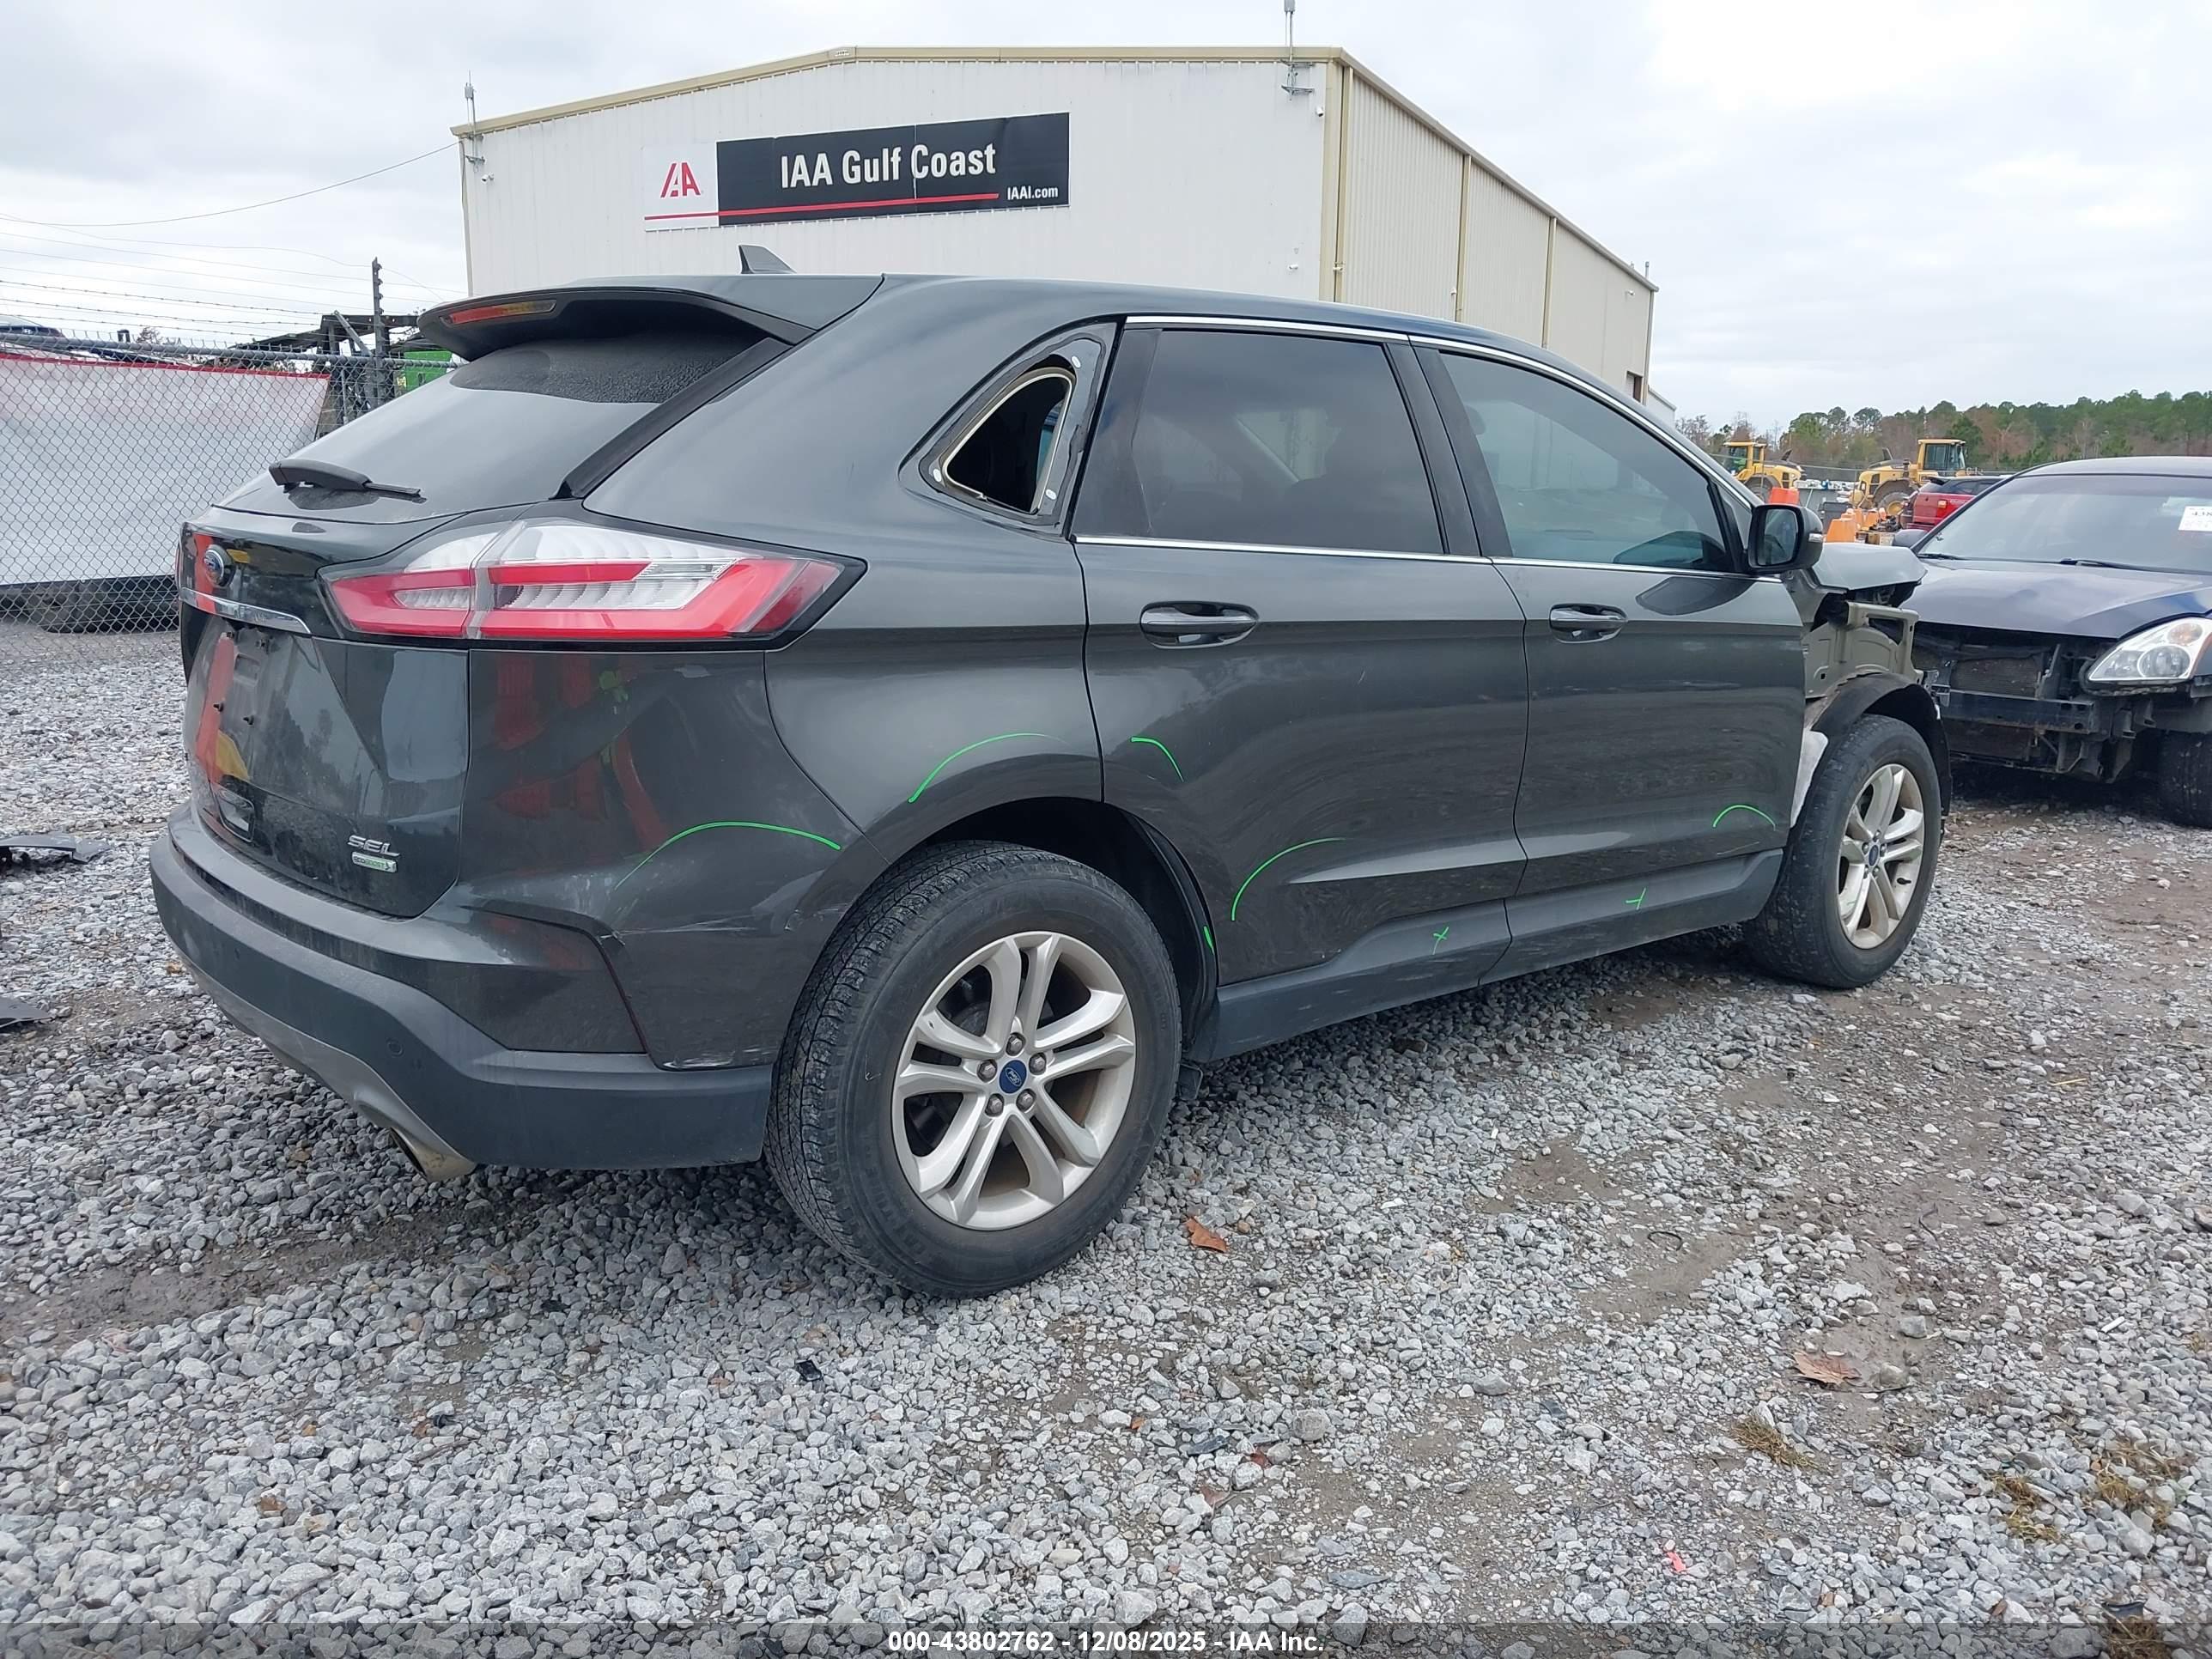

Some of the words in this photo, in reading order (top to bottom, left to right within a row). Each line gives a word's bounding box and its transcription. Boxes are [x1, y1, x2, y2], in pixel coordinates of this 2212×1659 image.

[781, 153, 833, 188] IAA
[842, 147, 902, 184] Gulf
[911, 143, 996, 179] Coast
[1007, 185, 1058, 200] IAAI.com
[348, 835, 400, 856] SEL
